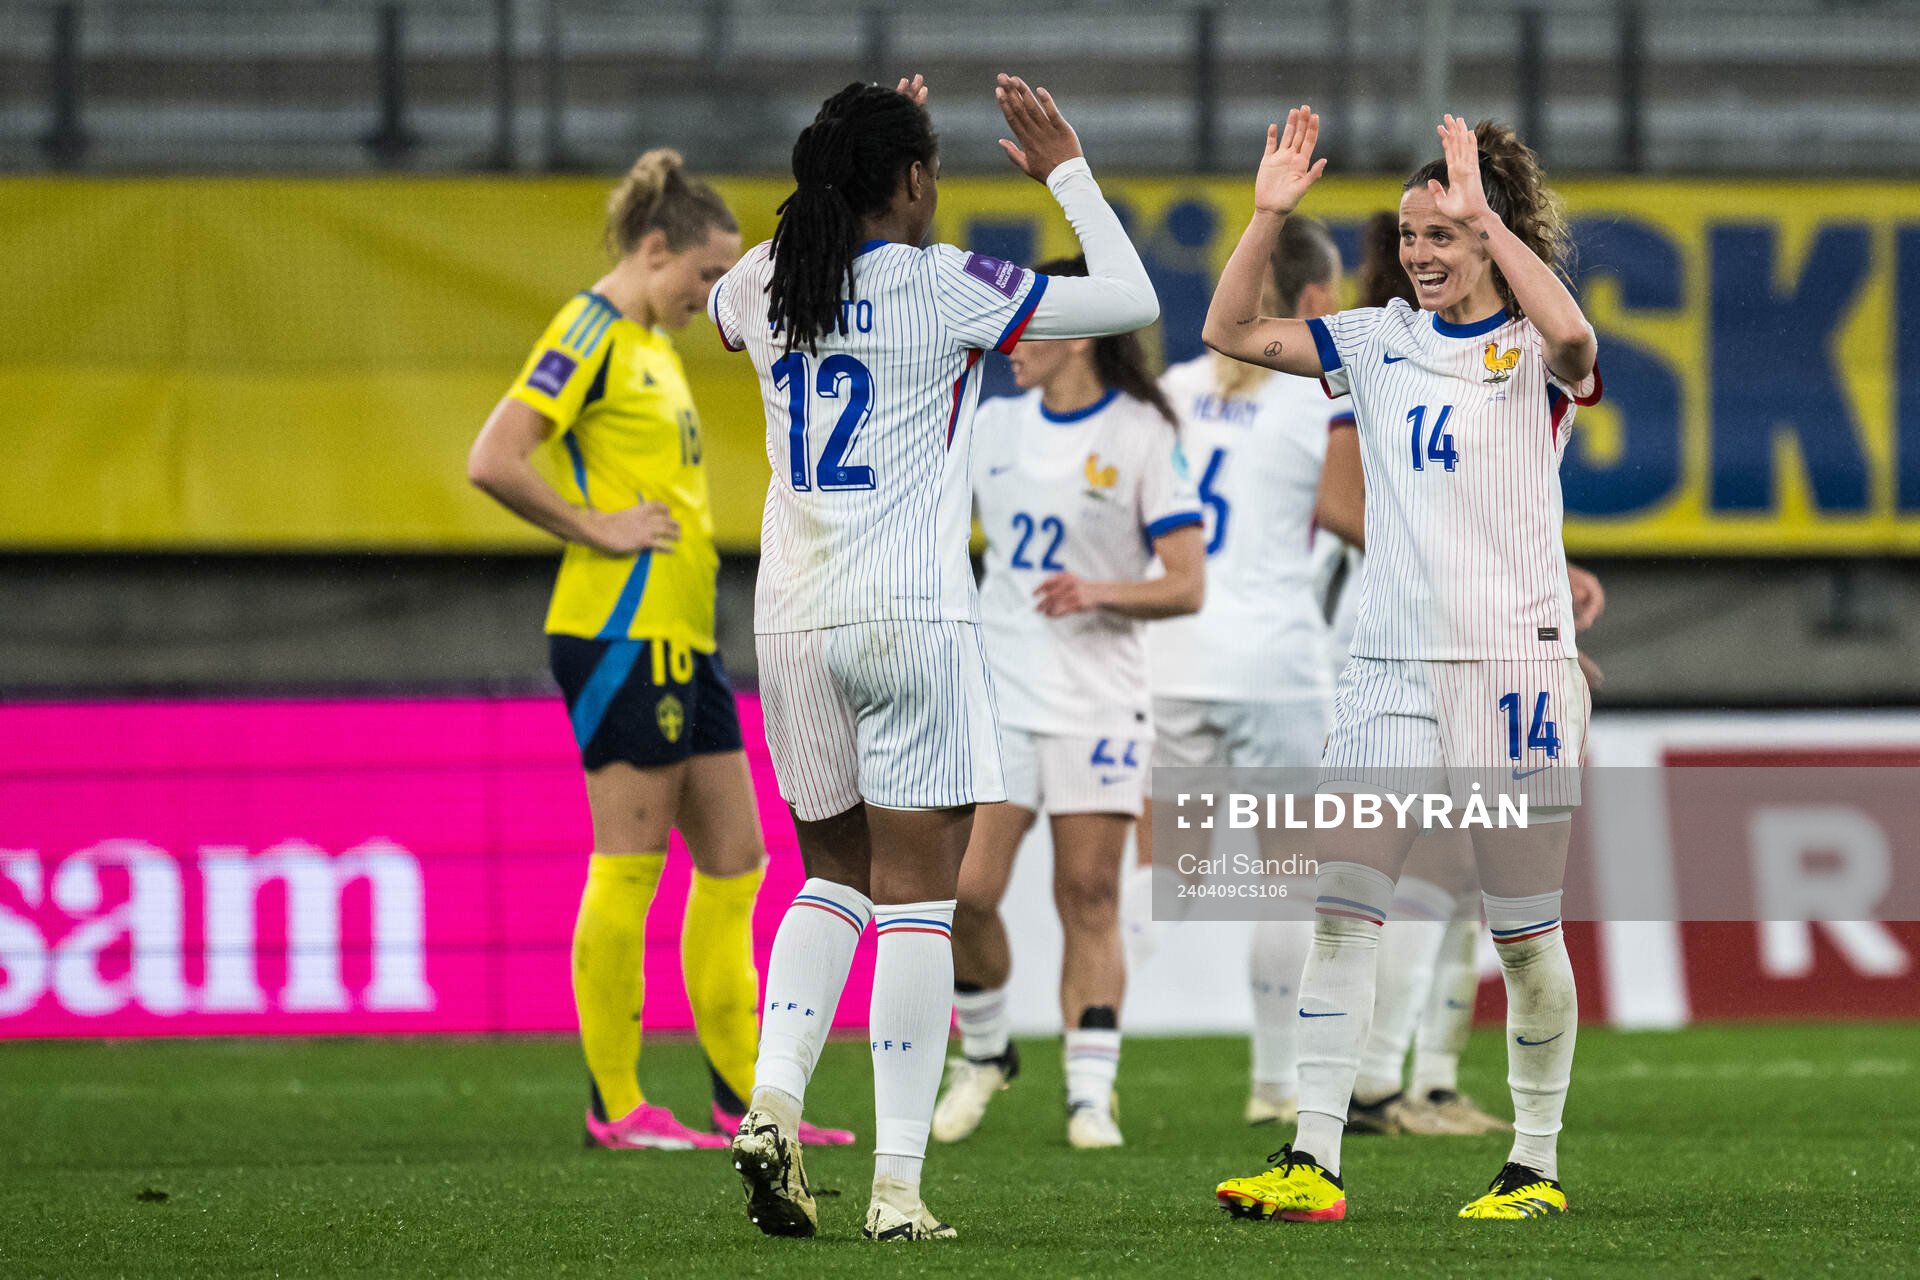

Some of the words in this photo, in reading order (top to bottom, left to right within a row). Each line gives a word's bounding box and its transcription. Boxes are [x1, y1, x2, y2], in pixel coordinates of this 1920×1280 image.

[771, 352, 876, 492] 12
[1407, 405, 1459, 472] 14
[1011, 512, 1066, 571] 22
[1499, 692, 1561, 760] 14
